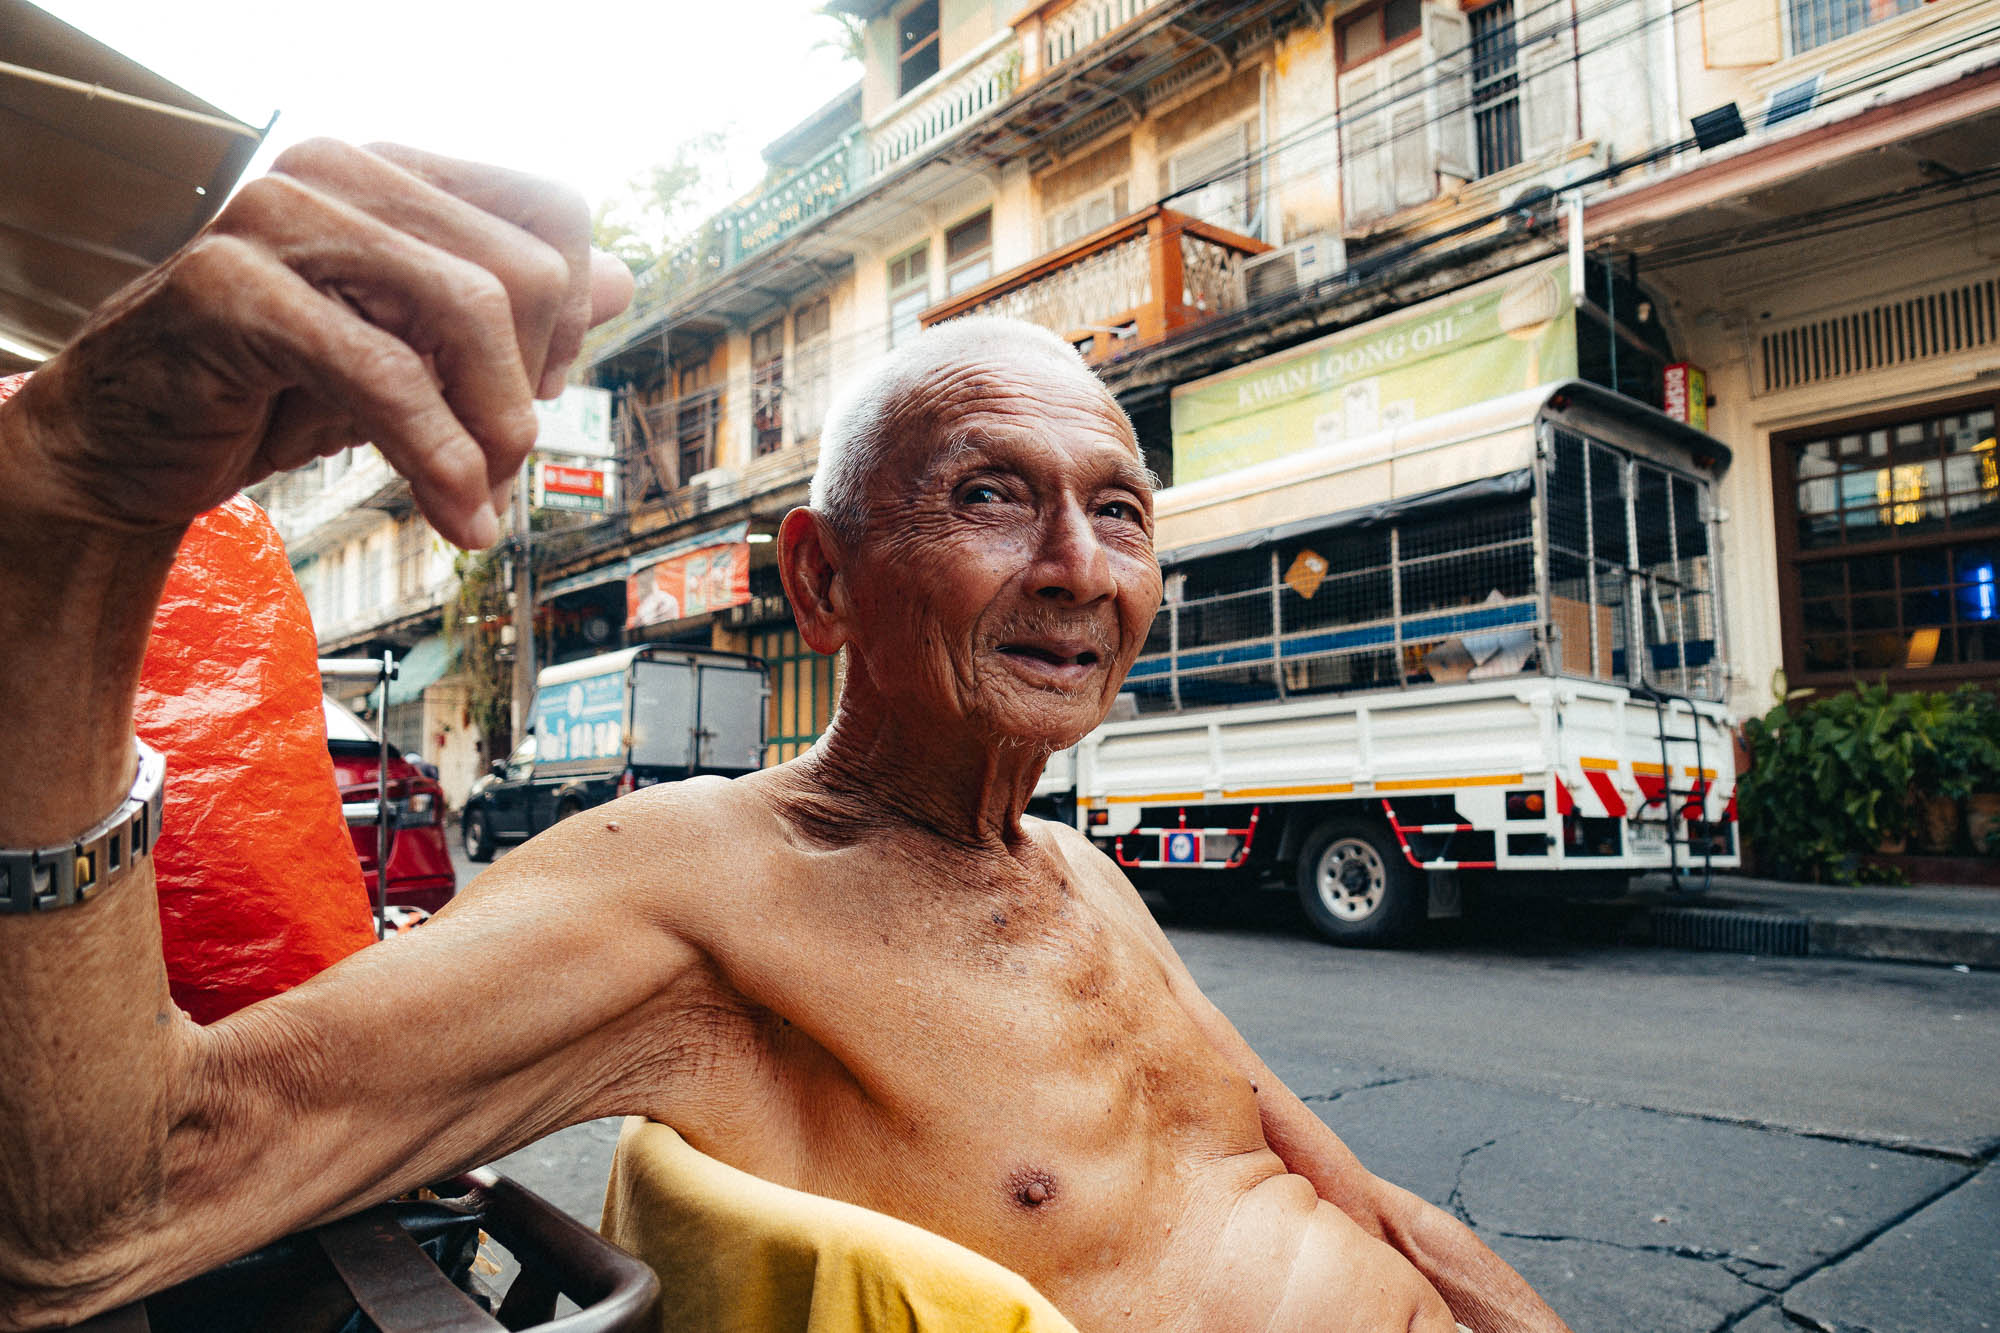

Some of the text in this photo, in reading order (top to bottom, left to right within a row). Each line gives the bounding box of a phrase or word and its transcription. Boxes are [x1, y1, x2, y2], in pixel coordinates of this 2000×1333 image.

[1238, 315, 1463, 408] KWAN LOONG OIL
